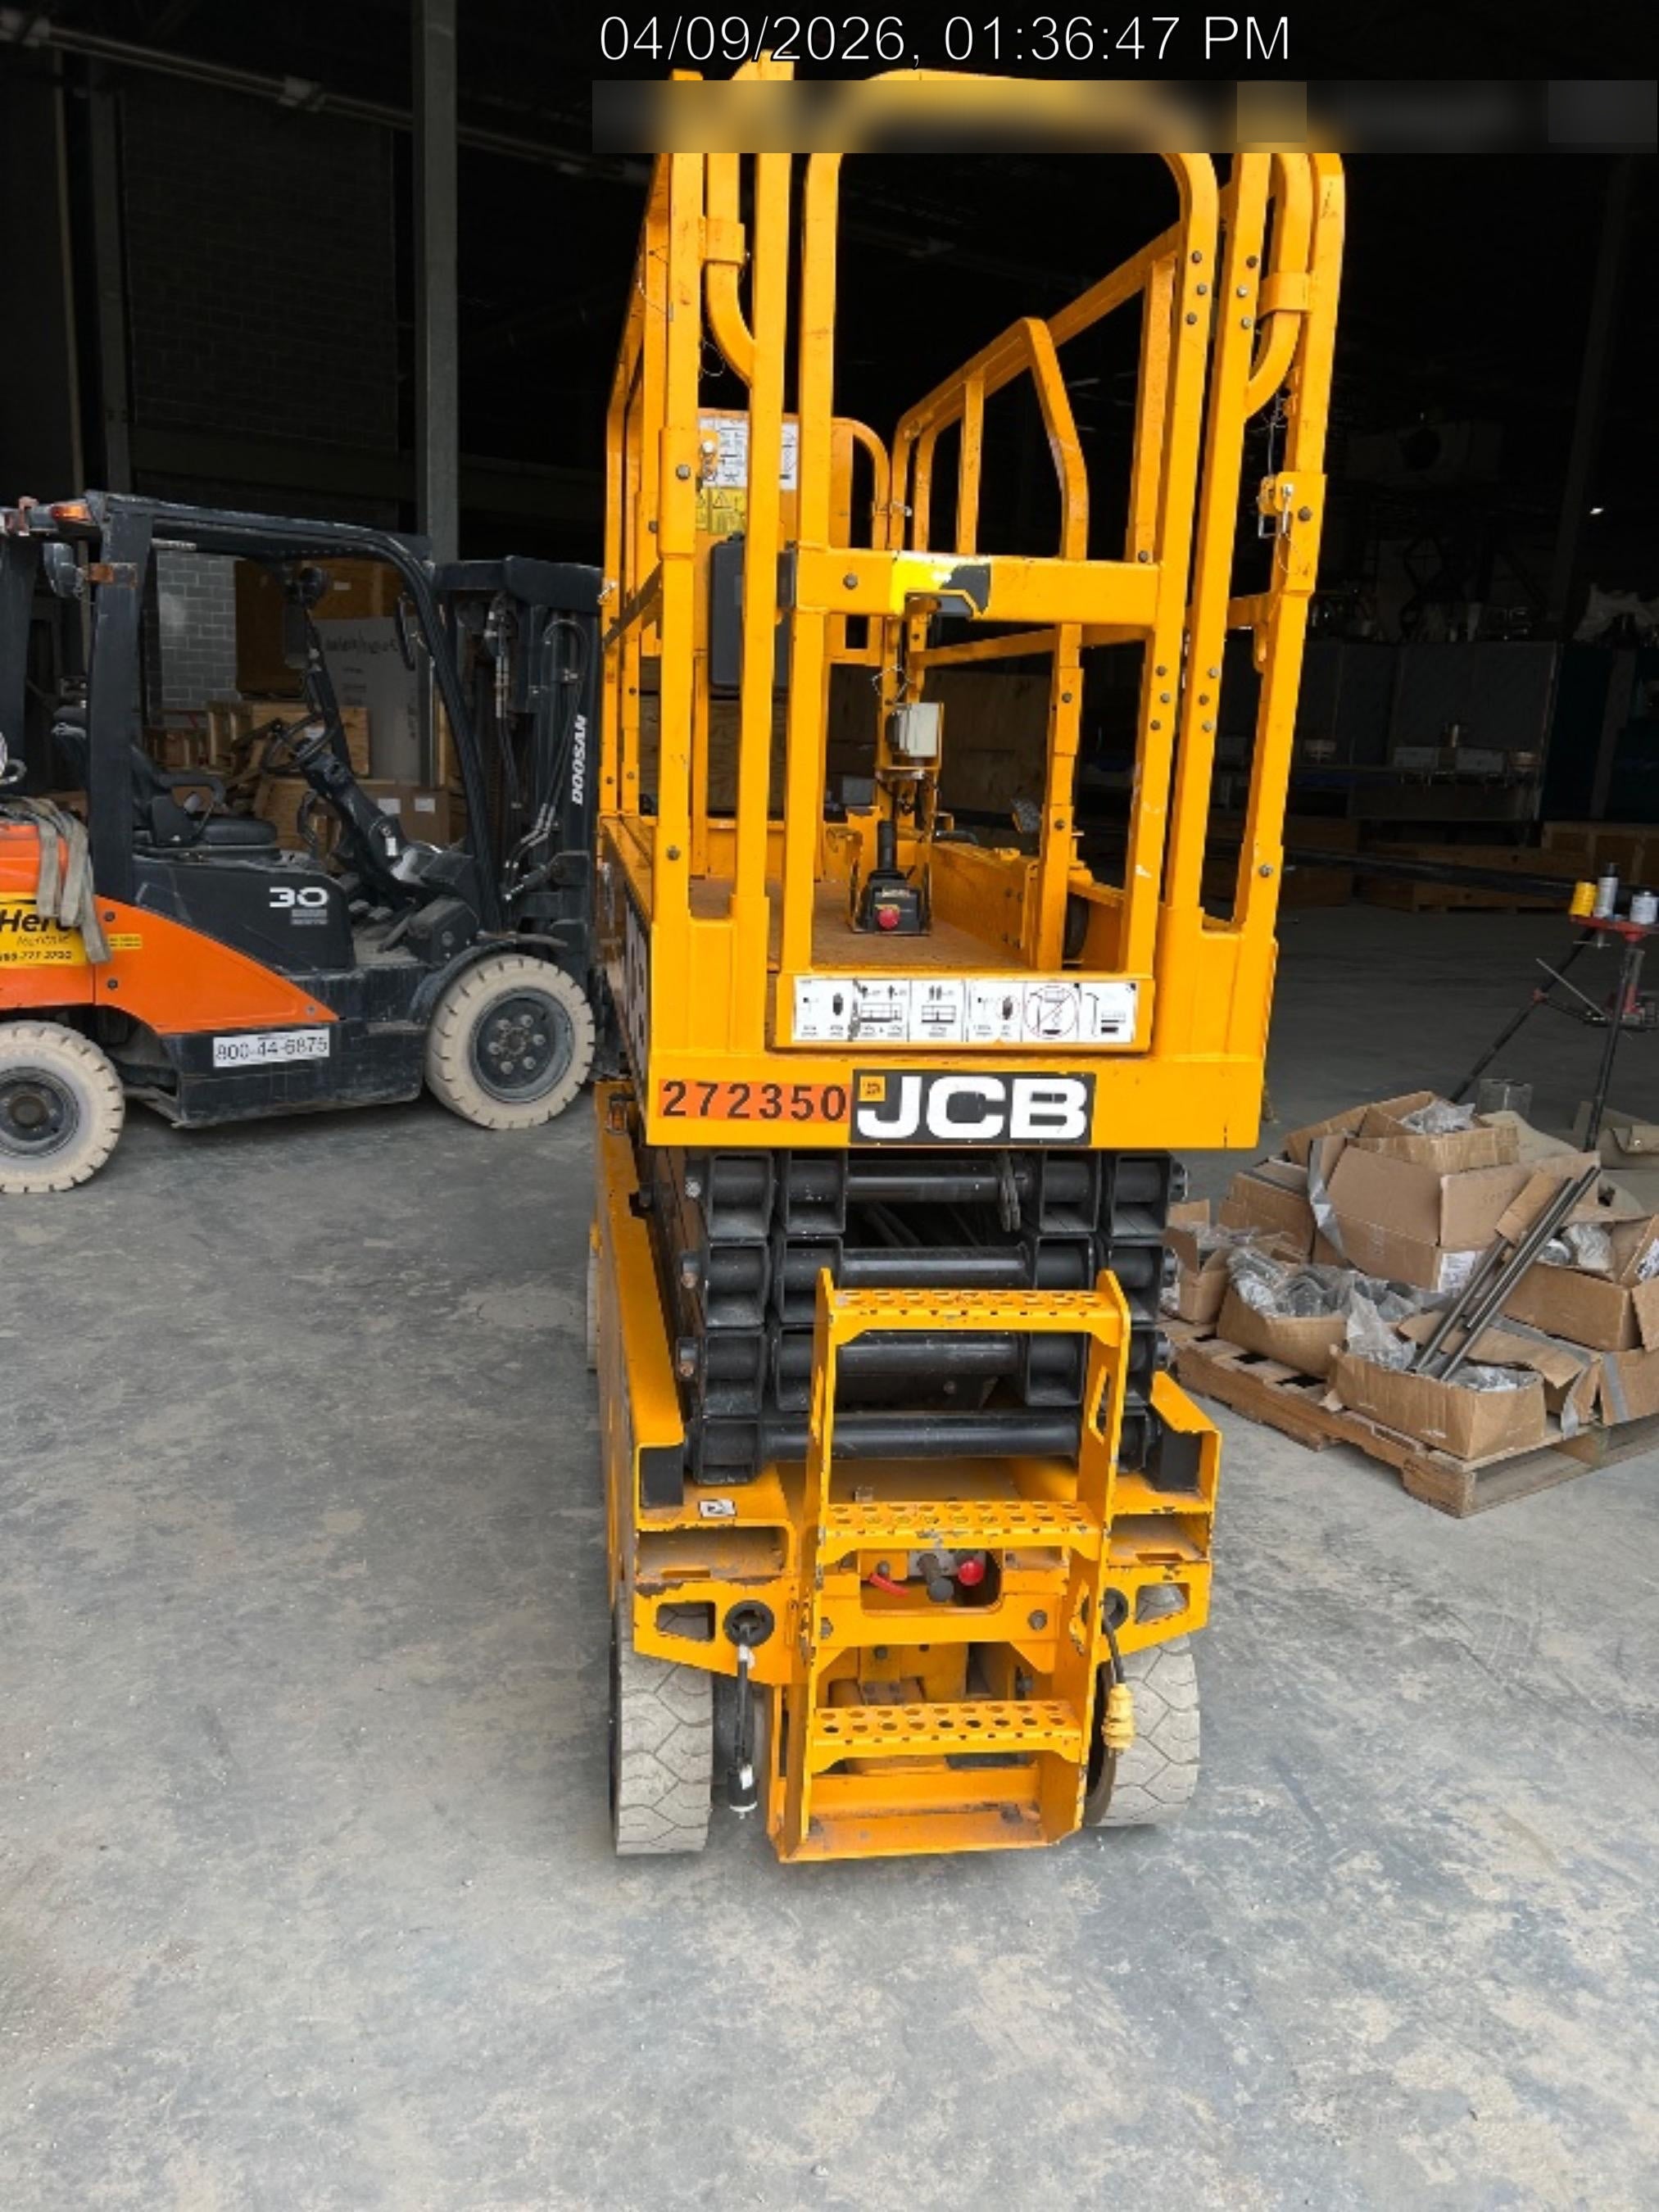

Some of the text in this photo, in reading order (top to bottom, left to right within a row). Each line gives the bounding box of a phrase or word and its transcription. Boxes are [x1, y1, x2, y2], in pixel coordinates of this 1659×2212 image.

[572, 714, 587, 805] DOOSAN
[270, 886, 329, 908] 30
[661, 1079, 846, 1122] 272350
[856, 1075, 1088, 1140] JCB
